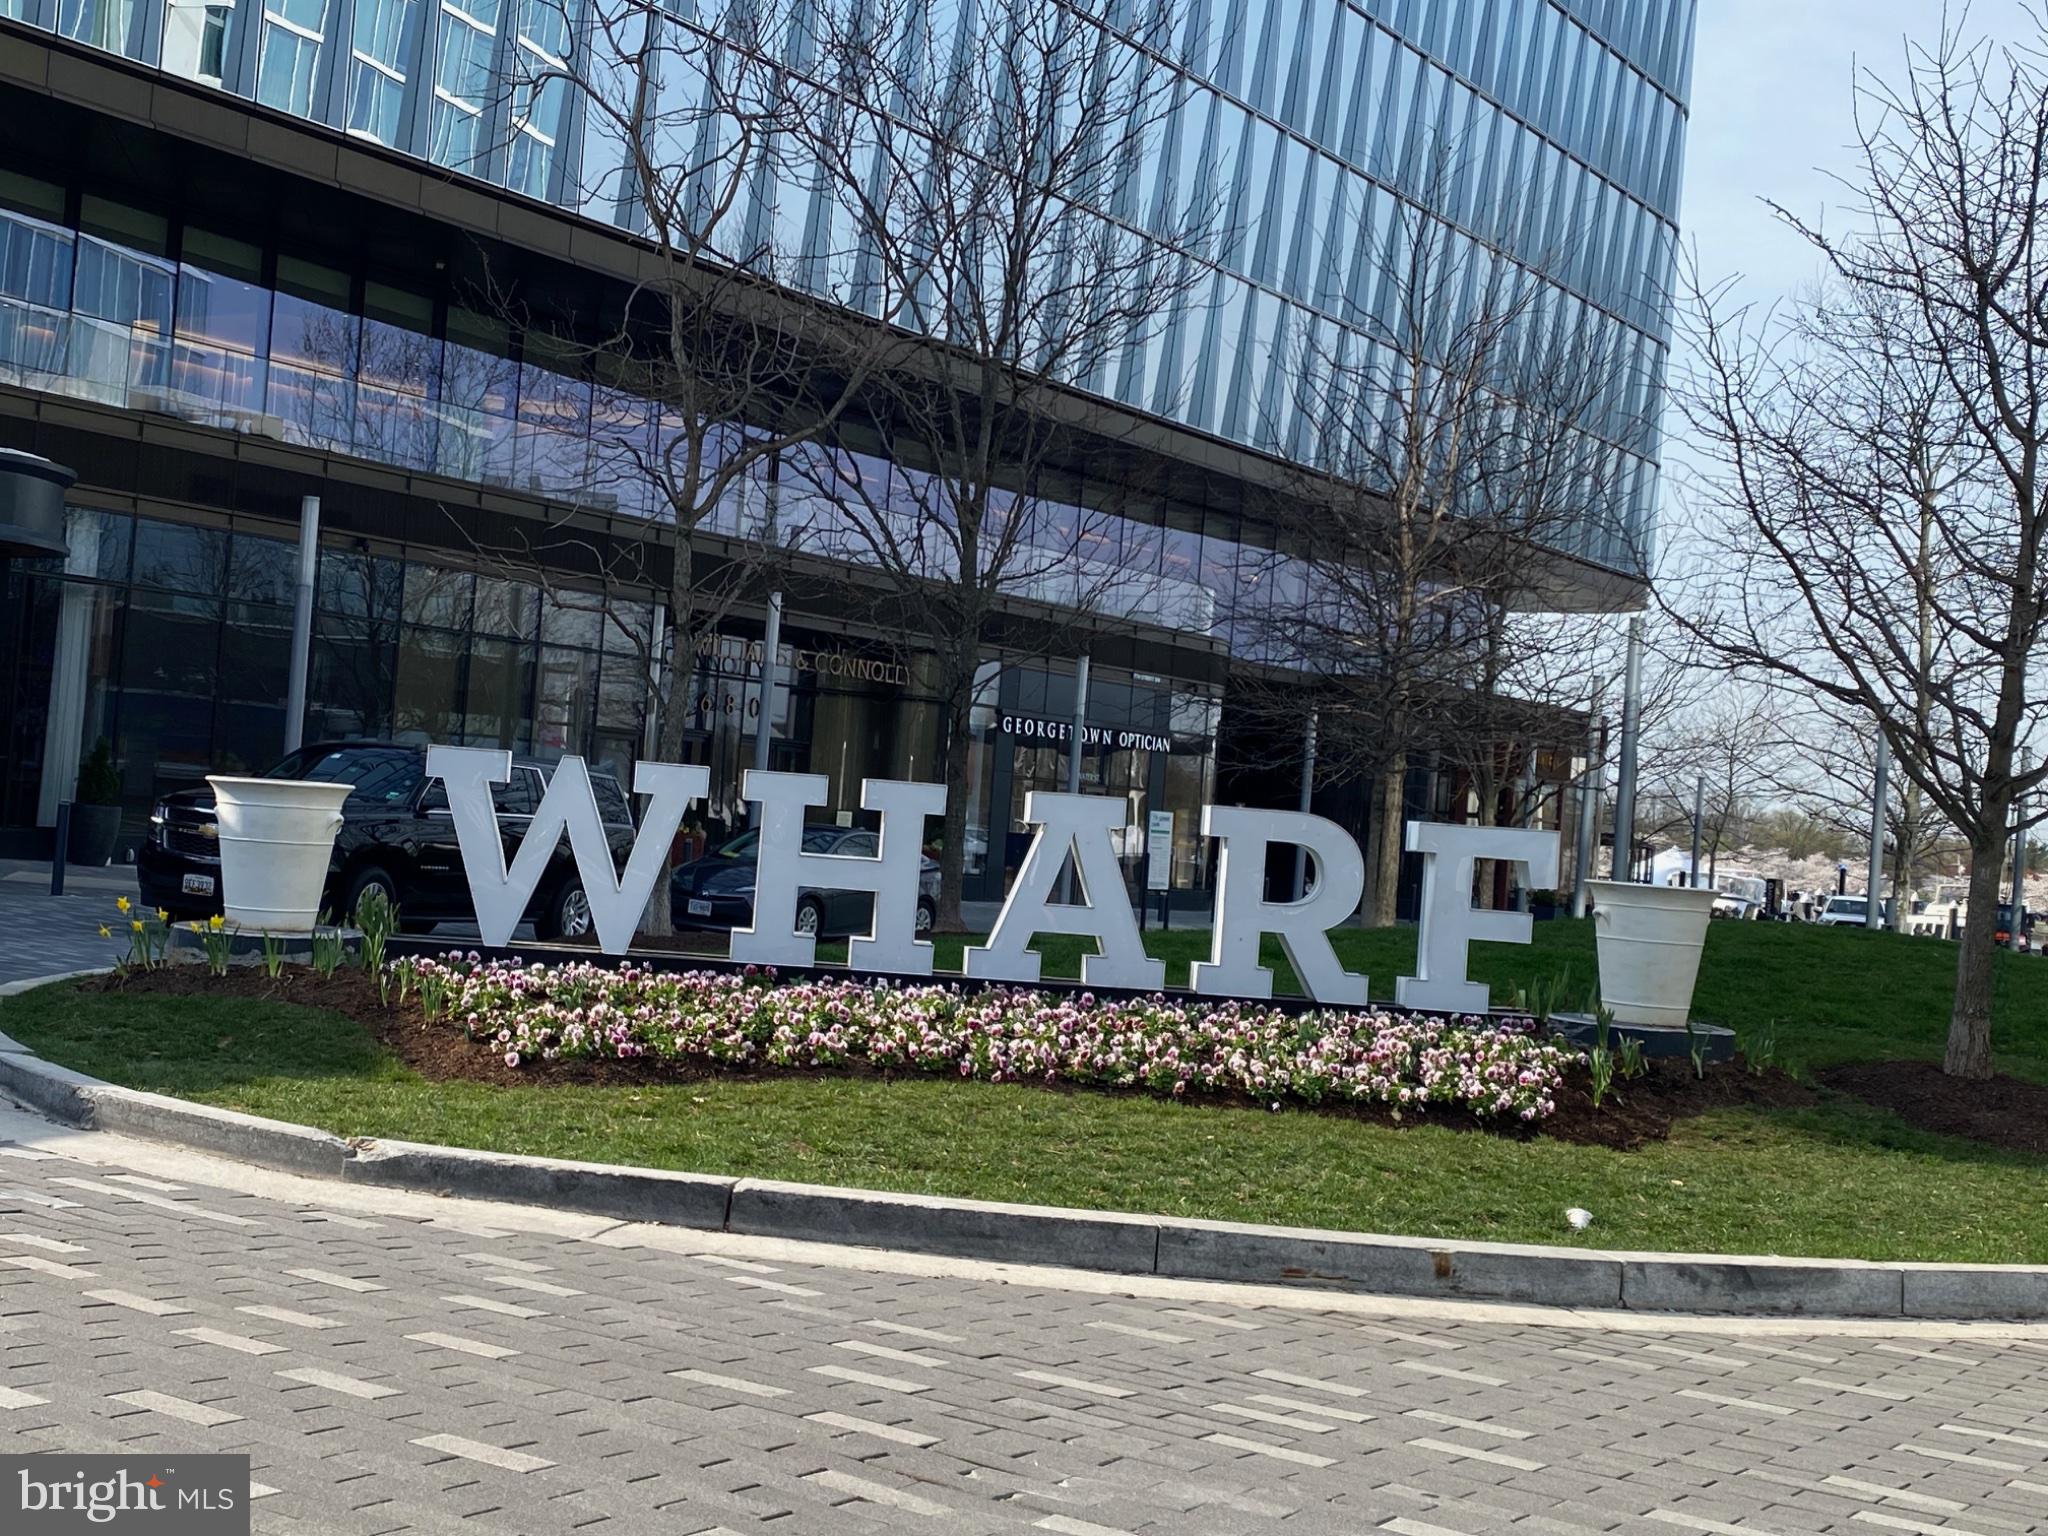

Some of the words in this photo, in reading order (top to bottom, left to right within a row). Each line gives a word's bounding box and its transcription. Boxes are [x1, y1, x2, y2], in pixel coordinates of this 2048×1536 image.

[691, 632, 790, 667] WILLIAS
[796, 650, 809, 670] &
[815, 652, 910, 686] CONNOLLY
[1119, 731, 1171, 752] OPTICIAN
[426, 744, 1561, 1015] WHARF
